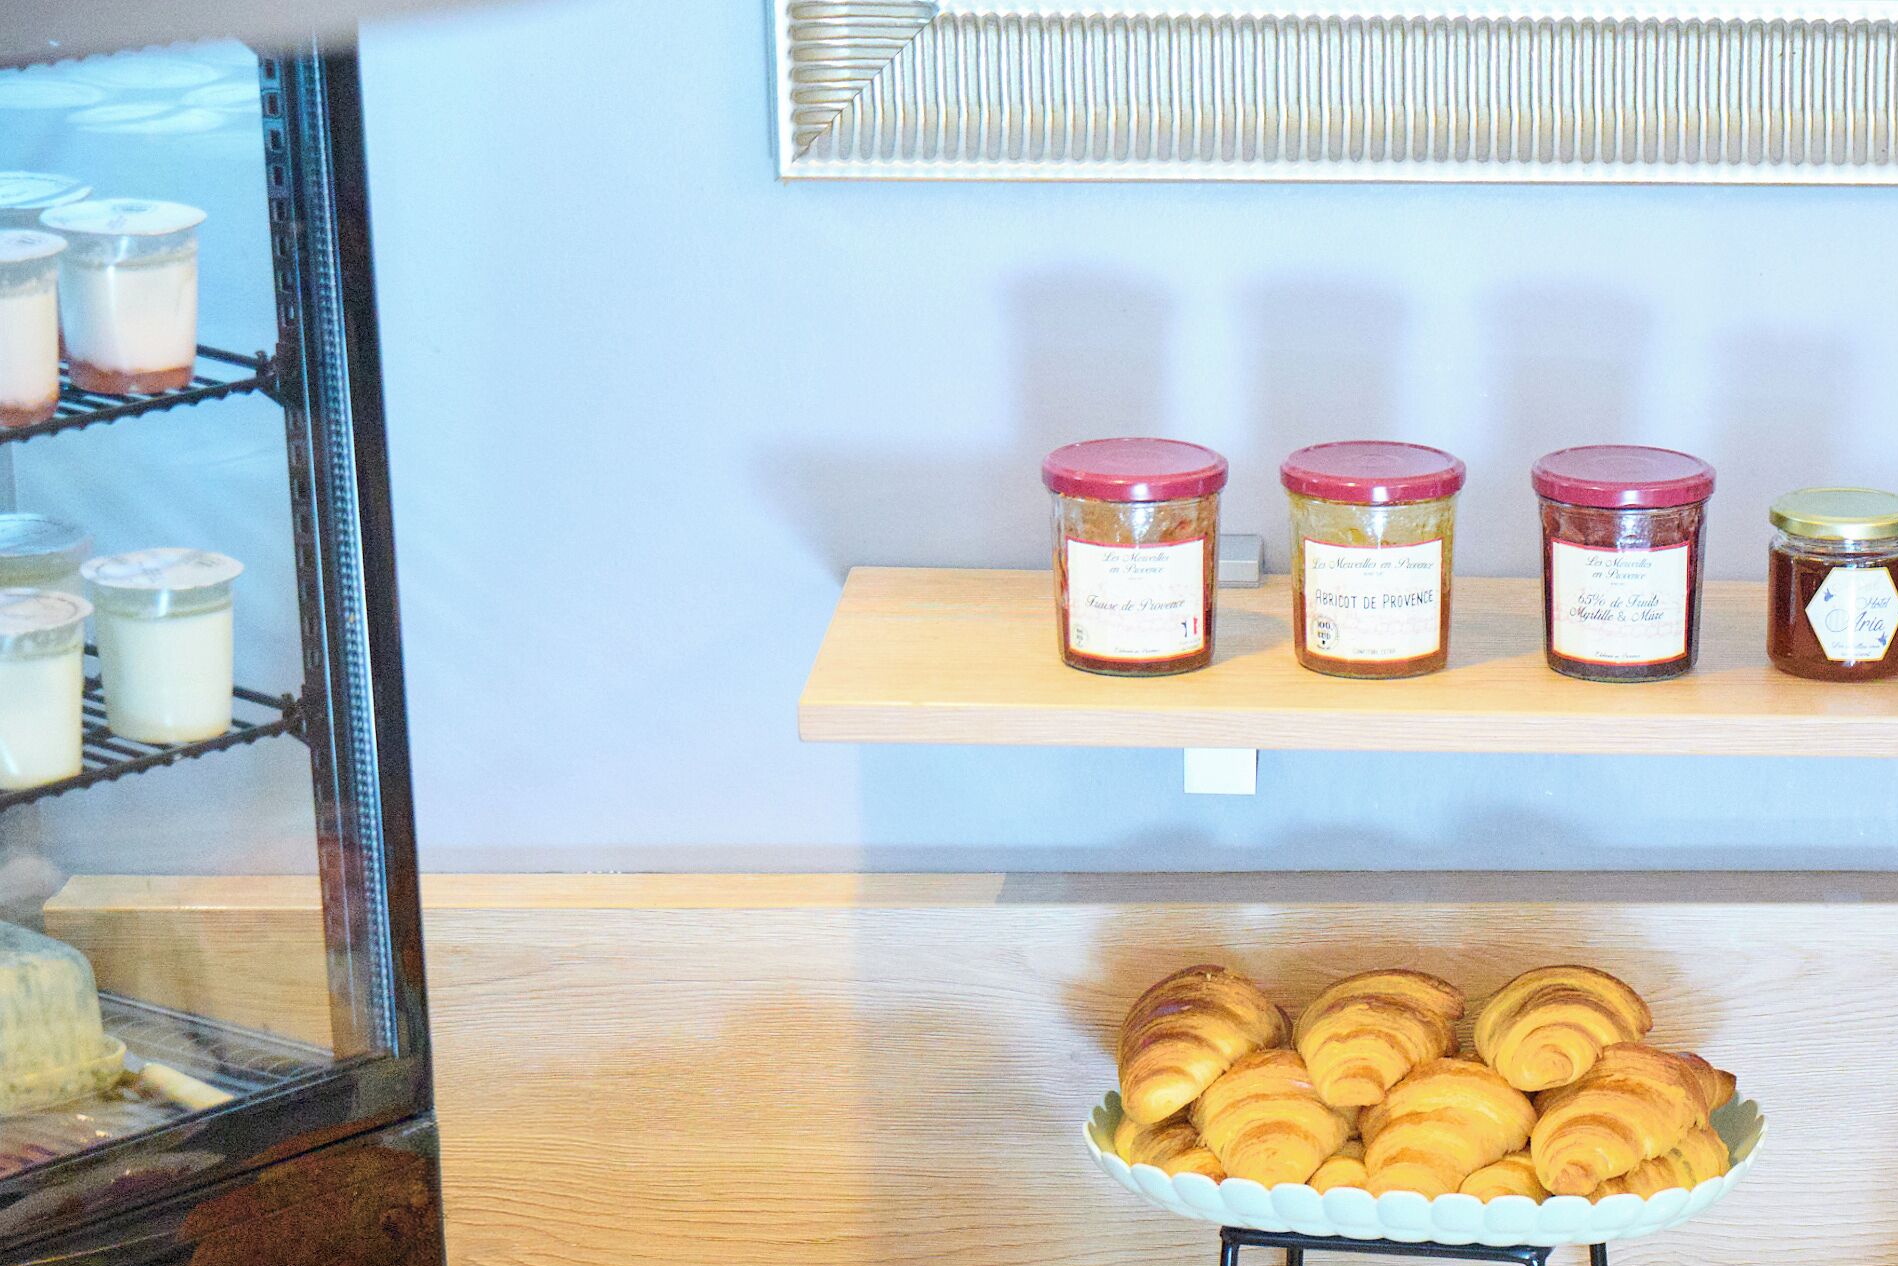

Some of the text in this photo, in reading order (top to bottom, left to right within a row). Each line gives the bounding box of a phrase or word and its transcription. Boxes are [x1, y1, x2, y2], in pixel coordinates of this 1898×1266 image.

[1102, 551, 1170, 563] Les Merveilles
[1311, 558, 1326, 570] Les
[1329, 556, 1377, 570] Merveilles
[1395, 557, 1434, 570] Provence
[1585, 555, 1652, 569] Les Merveilles
[1108, 563, 1166, 575] en Provence
[1591, 569, 1646, 580] en Provence
[1085, 594, 1186, 612] Fraise de Provence
[1315, 588, 1434, 610] ABRICOT DE PROVENCE
[1578, 592, 1659, 608] 65% de Fruits
[1569, 606, 1614, 623] Myrtille
[1617, 611, 1626, 622] &
[1825, 608, 1885, 633] Aria
